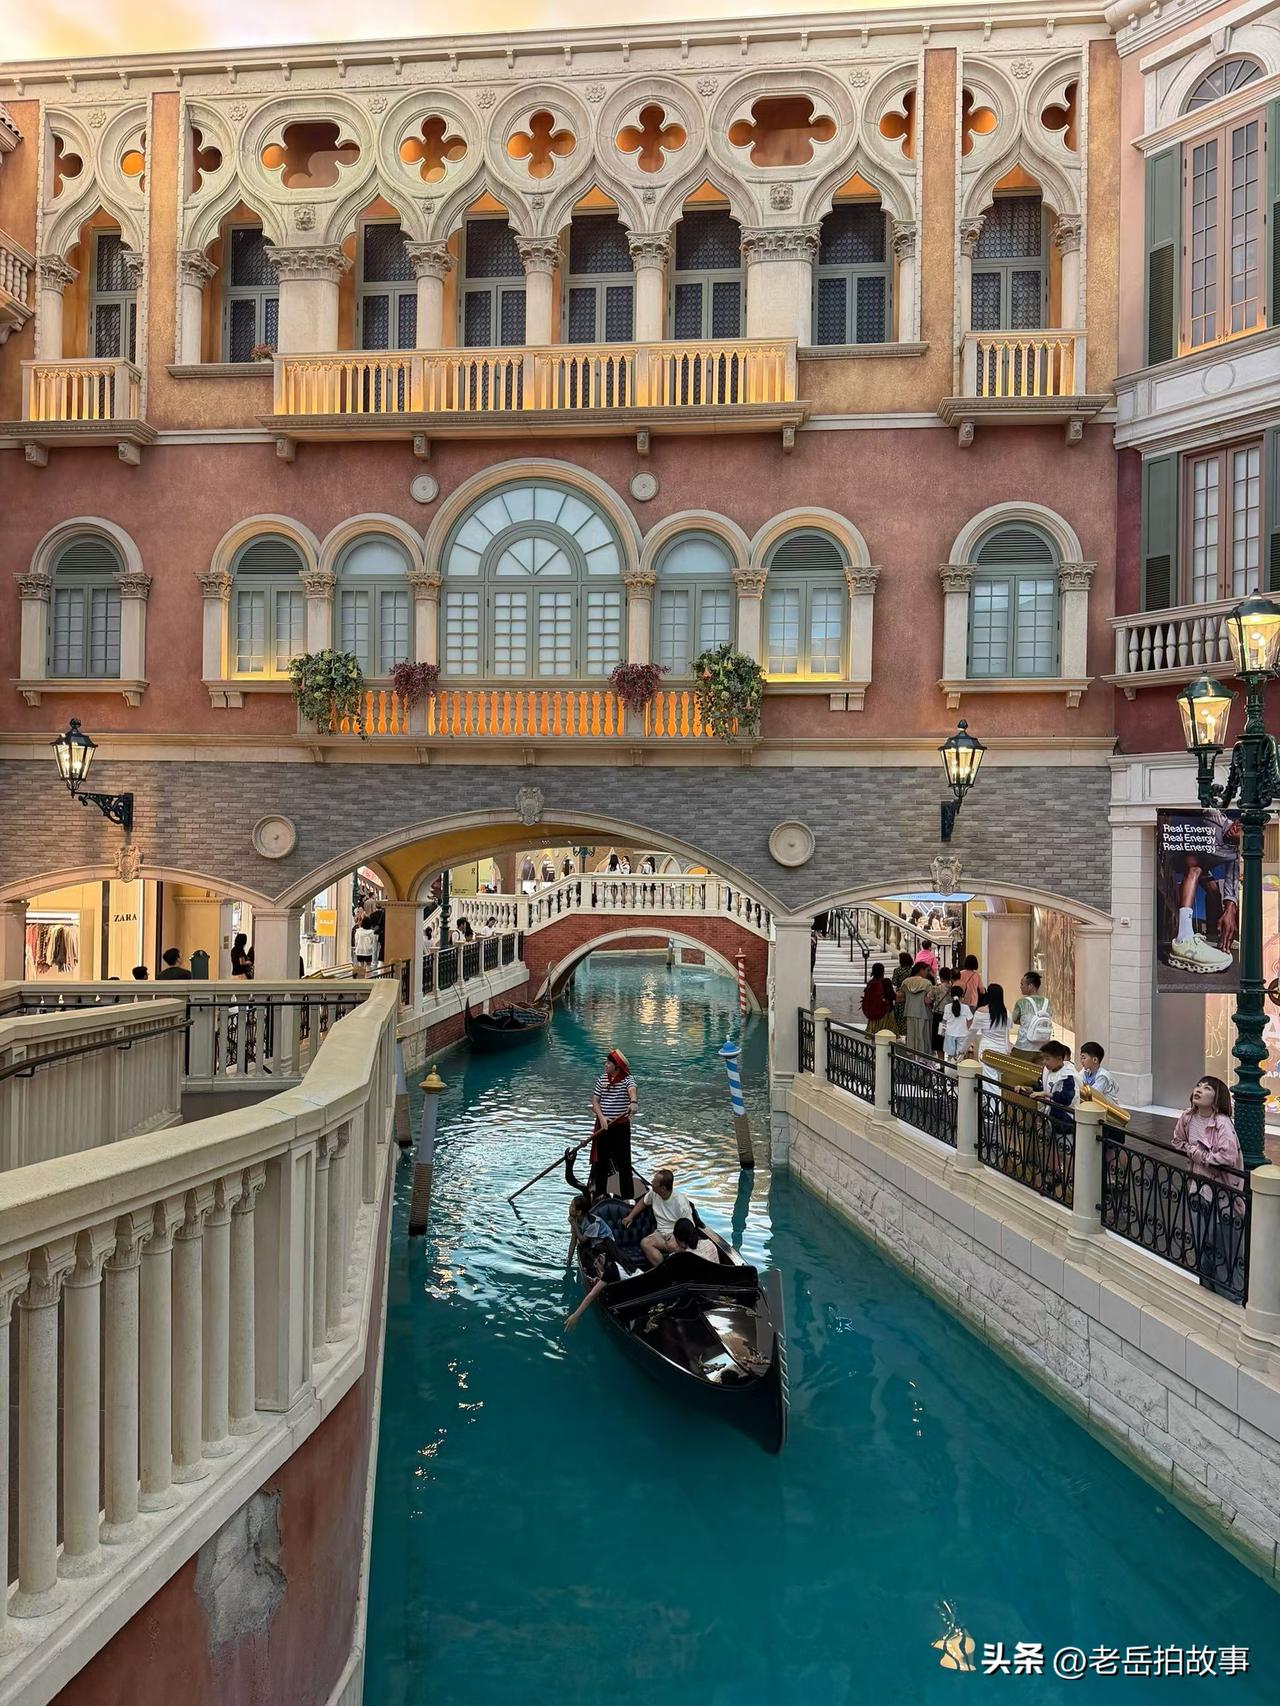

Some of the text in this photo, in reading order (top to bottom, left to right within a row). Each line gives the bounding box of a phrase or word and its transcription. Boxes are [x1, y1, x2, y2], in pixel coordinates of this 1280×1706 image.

[1163, 824, 1215, 835] Real Energy
[1163, 833, 1215, 844] Real Energy
[1163, 842, 1215, 853] Real Energy
[113, 913, 137, 922] ZARA
